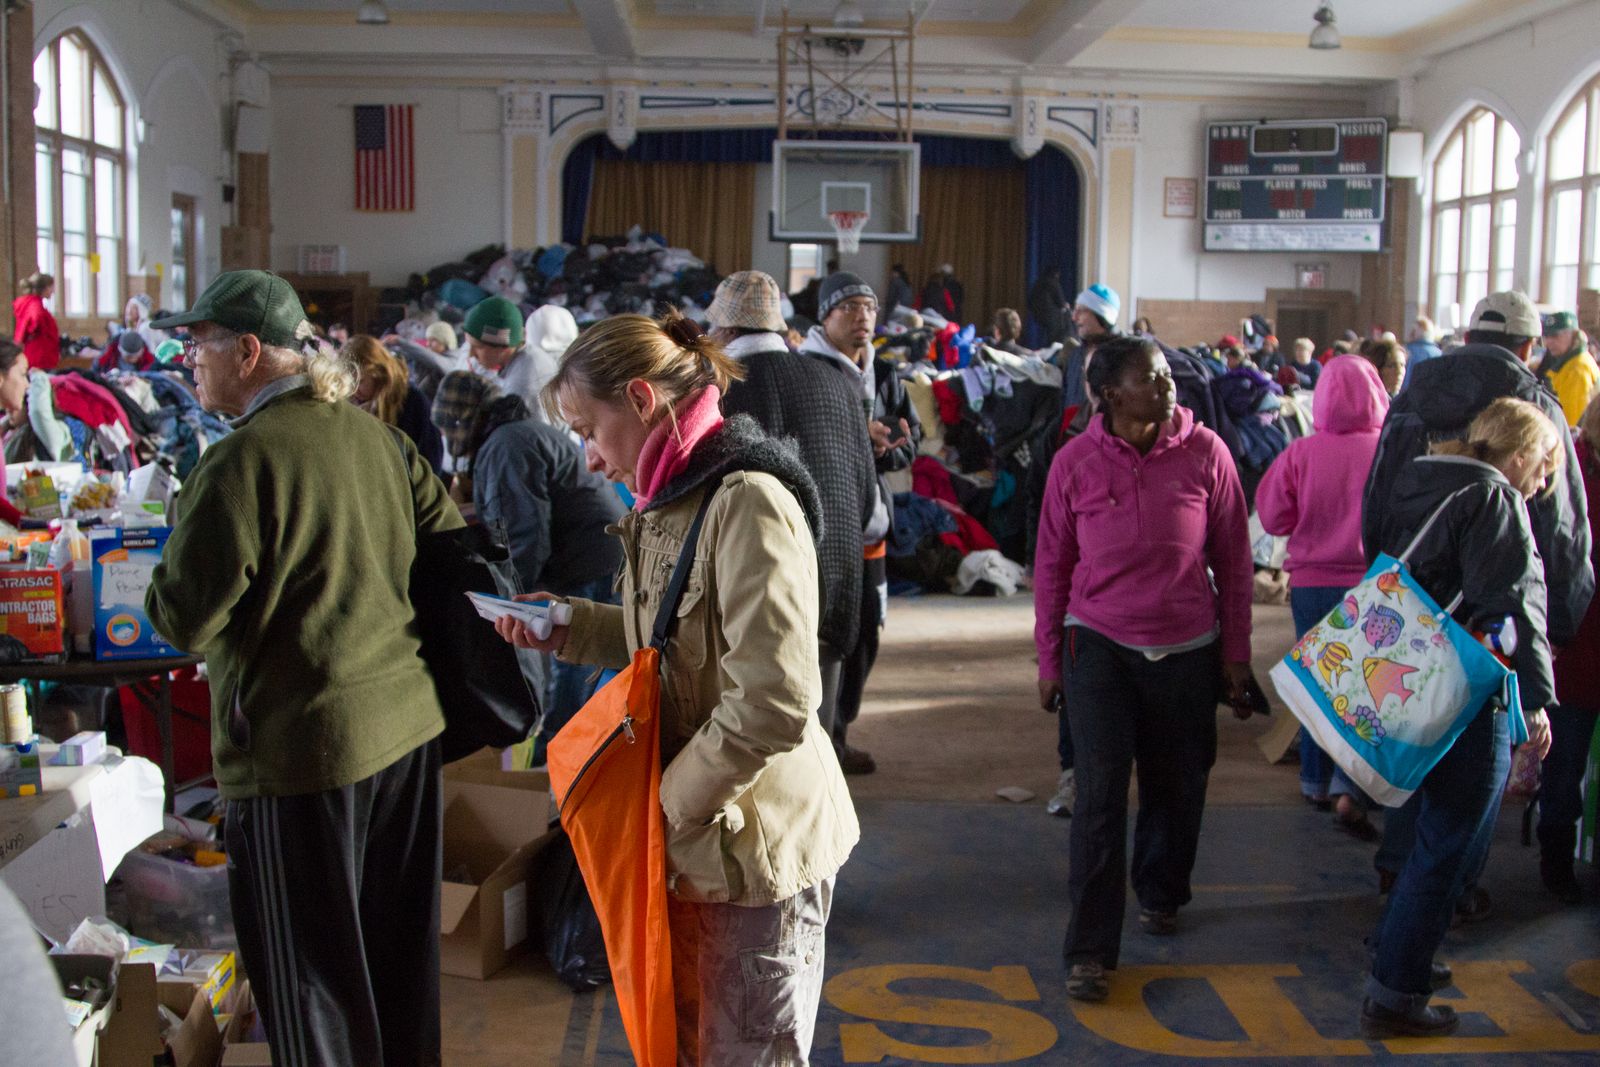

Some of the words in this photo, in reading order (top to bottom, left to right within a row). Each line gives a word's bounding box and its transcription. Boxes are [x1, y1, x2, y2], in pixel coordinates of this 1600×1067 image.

[1211, 126, 1249, 137] HOME
[1340, 123, 1383, 136] VISITOR
[1223, 164, 1250, 174] BONUS
[1273, 163, 1300, 173] PERIOD
[1338, 162, 1366, 172] BONUS
[1216, 180, 1242, 190] FOULS
[1264, 179, 1296, 190] PLAYER
[1301, 179, 1328, 190] FOULS
[1346, 179, 1372, 189] FOULS
[1214, 209, 1242, 219] POINTS
[1277, 208, 1307, 219] MATCH
[1343, 208, 1373, 219] POINTS
[122, 537, 157, 547] KIRKLAND
[27, 611, 57, 625] BAGS
